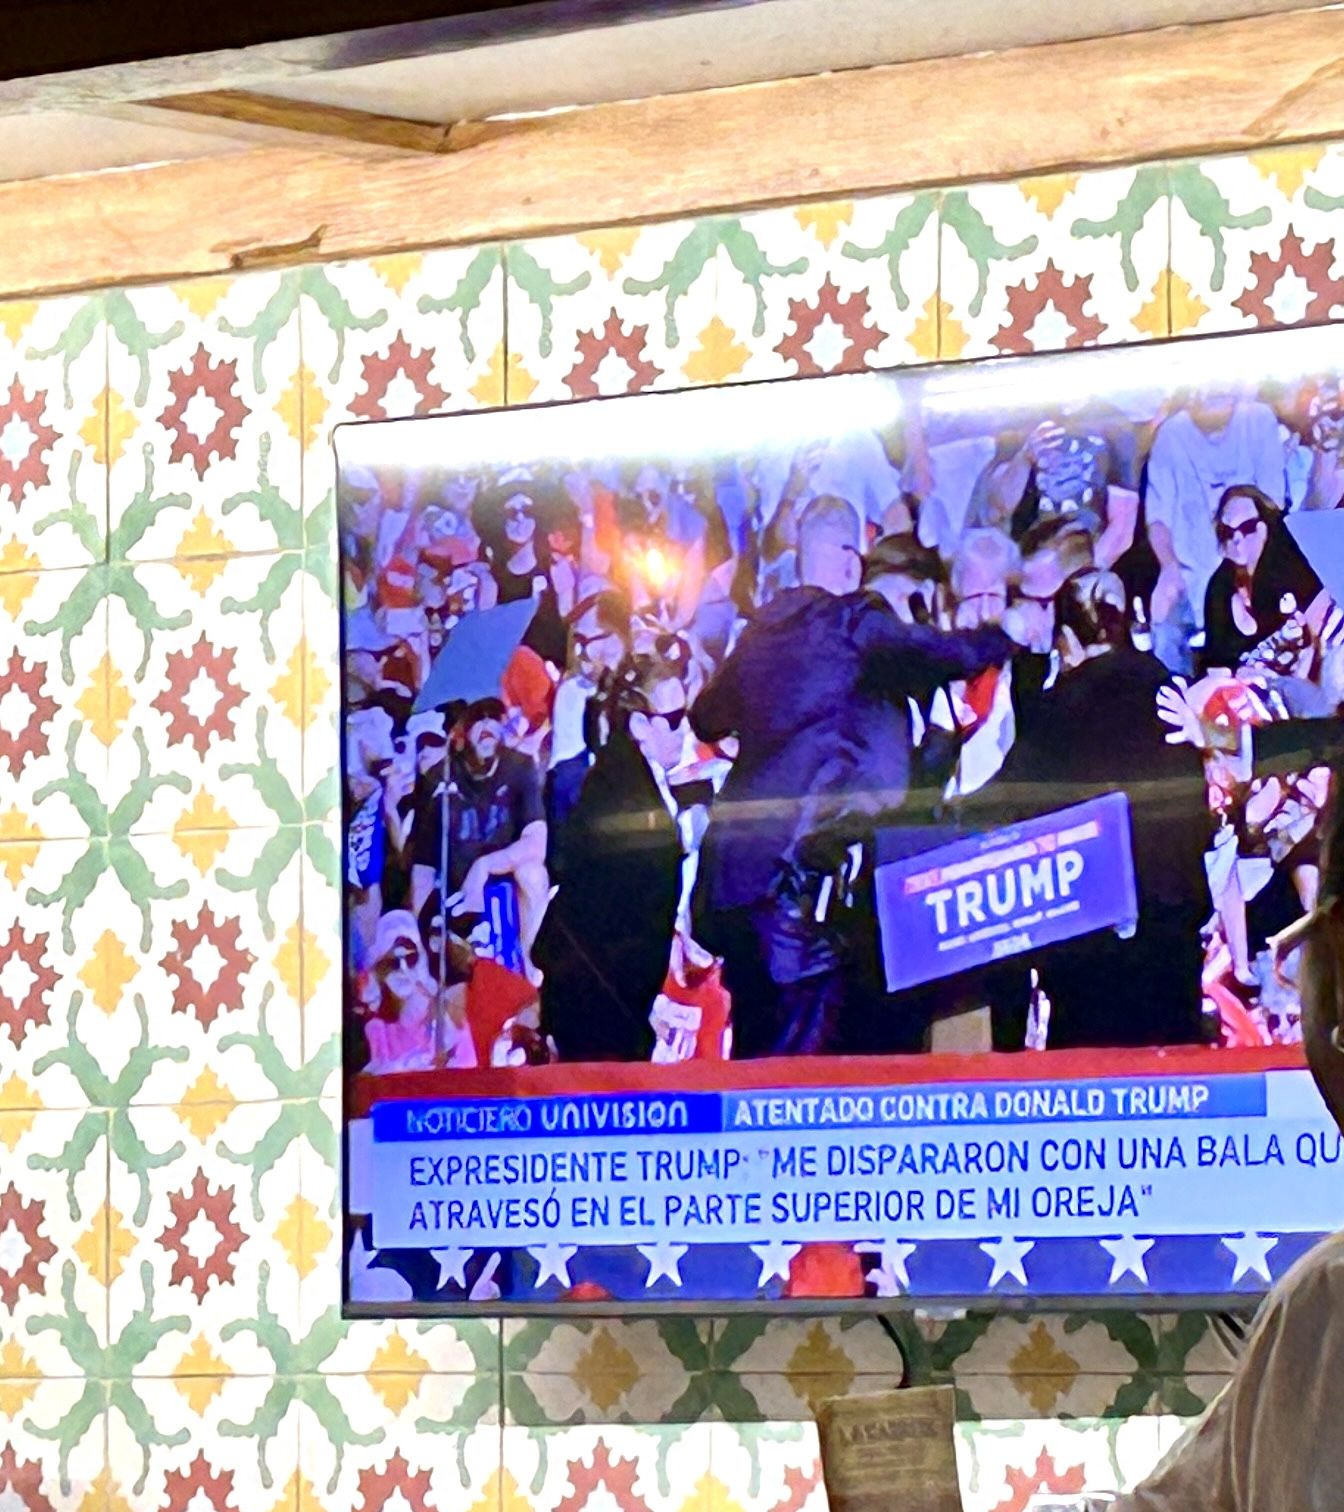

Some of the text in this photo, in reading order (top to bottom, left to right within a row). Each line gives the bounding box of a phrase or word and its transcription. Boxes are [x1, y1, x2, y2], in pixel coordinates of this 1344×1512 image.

[924, 849, 1085, 934] TRUMP
[407, 1103, 532, 1134] NOTICIERO
[734, 1084, 1210, 1126] ATENTADO CONTRA DONALD TRUMP
[410, 1151, 628, 1187] EXPRESIDENTE
[827, 1140, 1029, 1177] DISPARARON
[1041, 1137, 1106, 1171] CON
[1118, 1135, 1186, 1170] UNA
[1197, 1132, 1285, 1168] BALA
[409, 1187, 561, 1231] ATRAVESÓ
[571, 1195, 608, 1228] EN
[619, 1195, 655, 1227] EL
[665, 1193, 761, 1227] PARTE
[771, 1190, 925, 1224] SUPERIOR
[936, 1188, 976, 1221] DE
[988, 1187, 1020, 1220] MI
